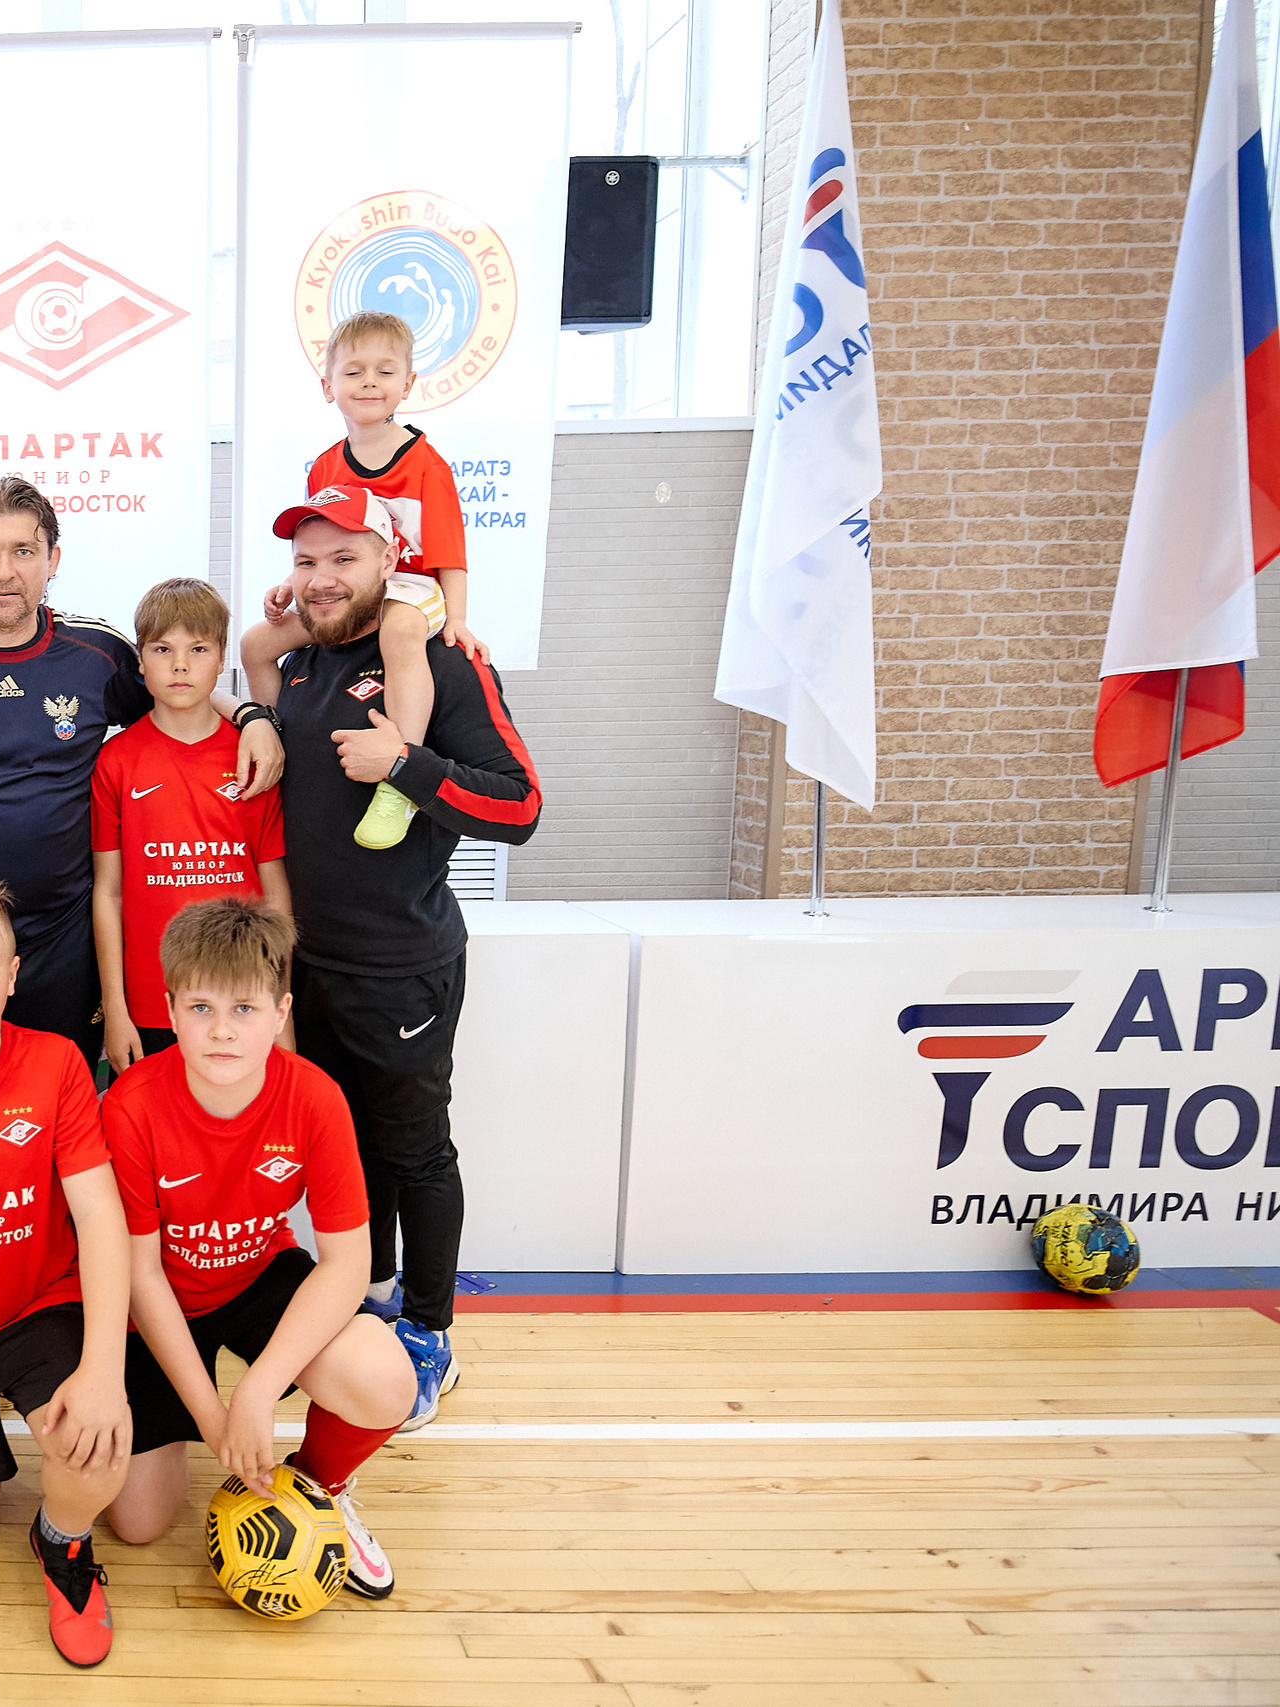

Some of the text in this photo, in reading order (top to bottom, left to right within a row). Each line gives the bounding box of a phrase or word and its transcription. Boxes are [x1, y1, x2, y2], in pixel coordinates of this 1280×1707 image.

[476, 245, 507, 287] Kai
[420, 335, 498, 401] Karate
[450, 460, 511, 477] АРАТЭ
[46, 495, 146, 513] ВОСТОК
[474, 512, 526, 528] КРАЯ
[143, 841, 246, 858] СПАРТАК
[172, 860, 225, 870] ЮНИОР
[146, 871, 245, 887] ВЛАДИВОСТОК
[1095, 967, 1280, 1053] АР
[198, 1236, 263, 1255] ЮНИОР
